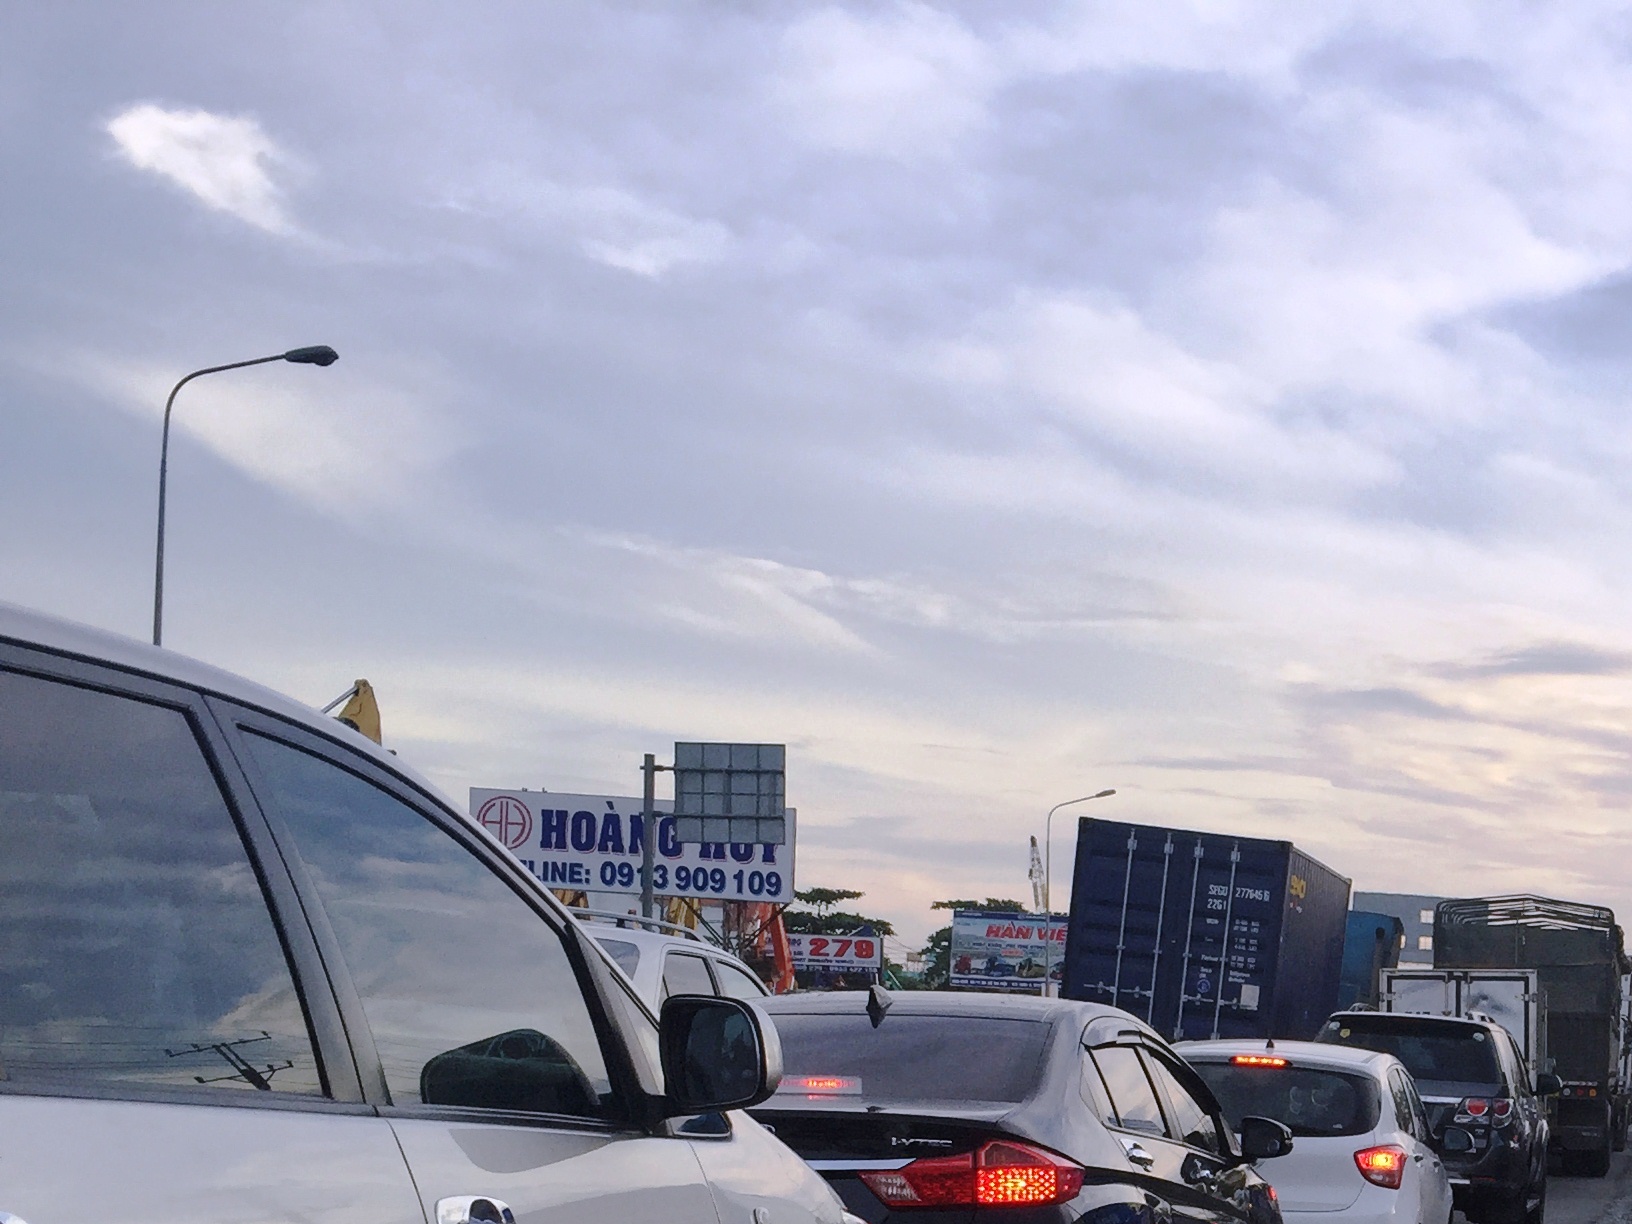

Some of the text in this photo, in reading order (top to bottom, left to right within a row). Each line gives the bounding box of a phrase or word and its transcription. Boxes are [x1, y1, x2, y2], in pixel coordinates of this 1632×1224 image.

[675, 866, 727, 893] 909
[733, 869, 782, 896] 109
[985, 921, 1032, 940] HÀN
